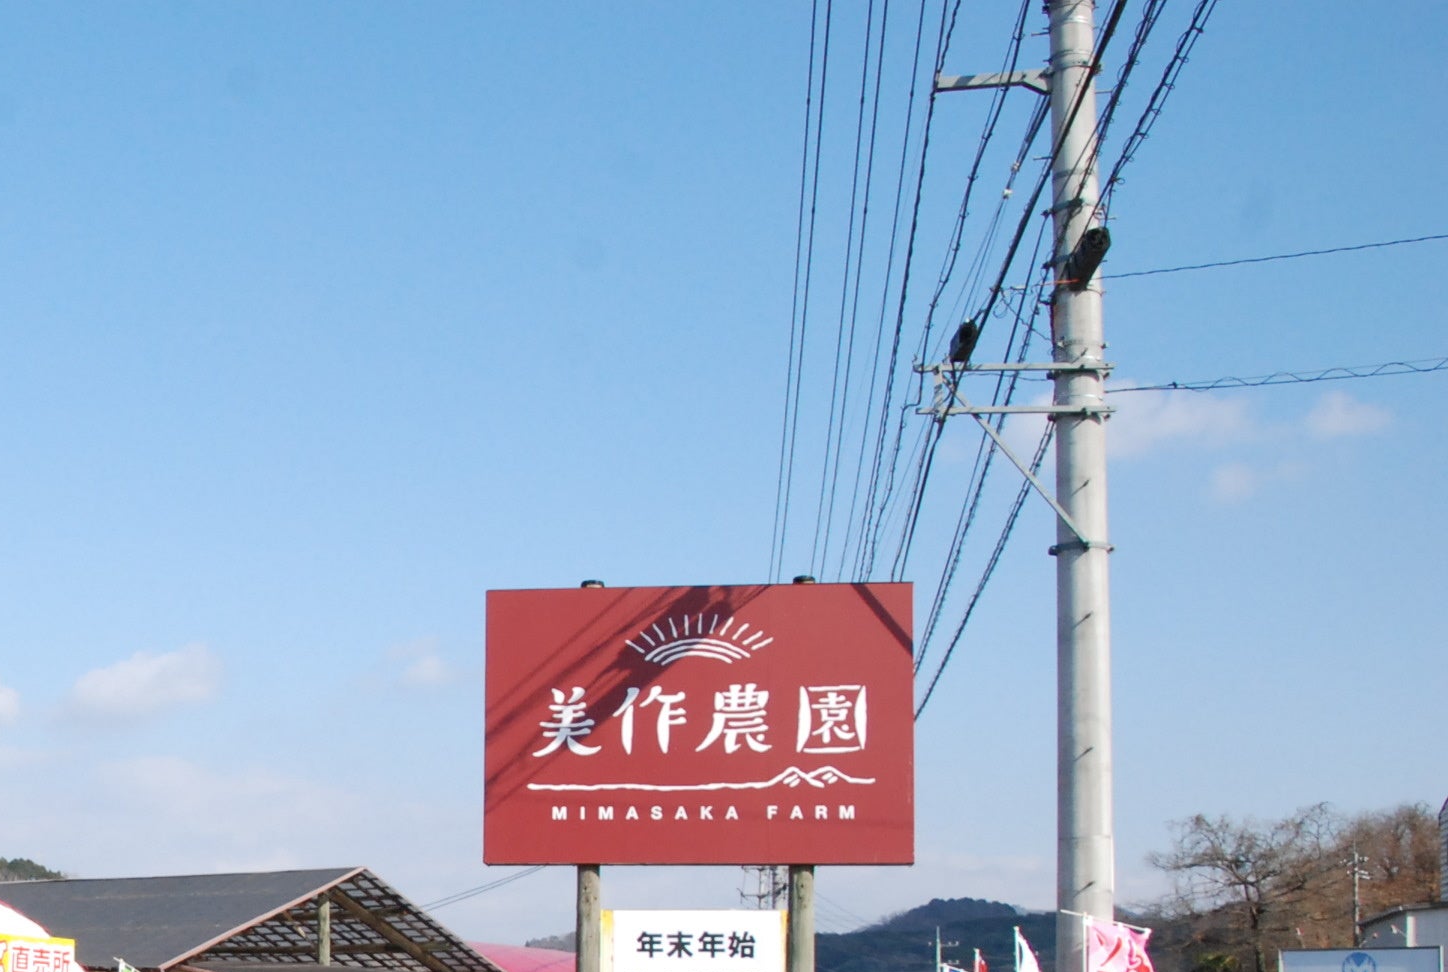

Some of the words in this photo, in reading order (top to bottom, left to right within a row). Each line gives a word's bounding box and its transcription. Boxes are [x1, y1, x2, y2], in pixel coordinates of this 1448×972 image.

[532, 683, 867, 758] 美作農園
[551, 804, 740, 821] MIMASAKA
[766, 803, 857, 820] FARM
[636, 930, 757, 960] 年末年始
